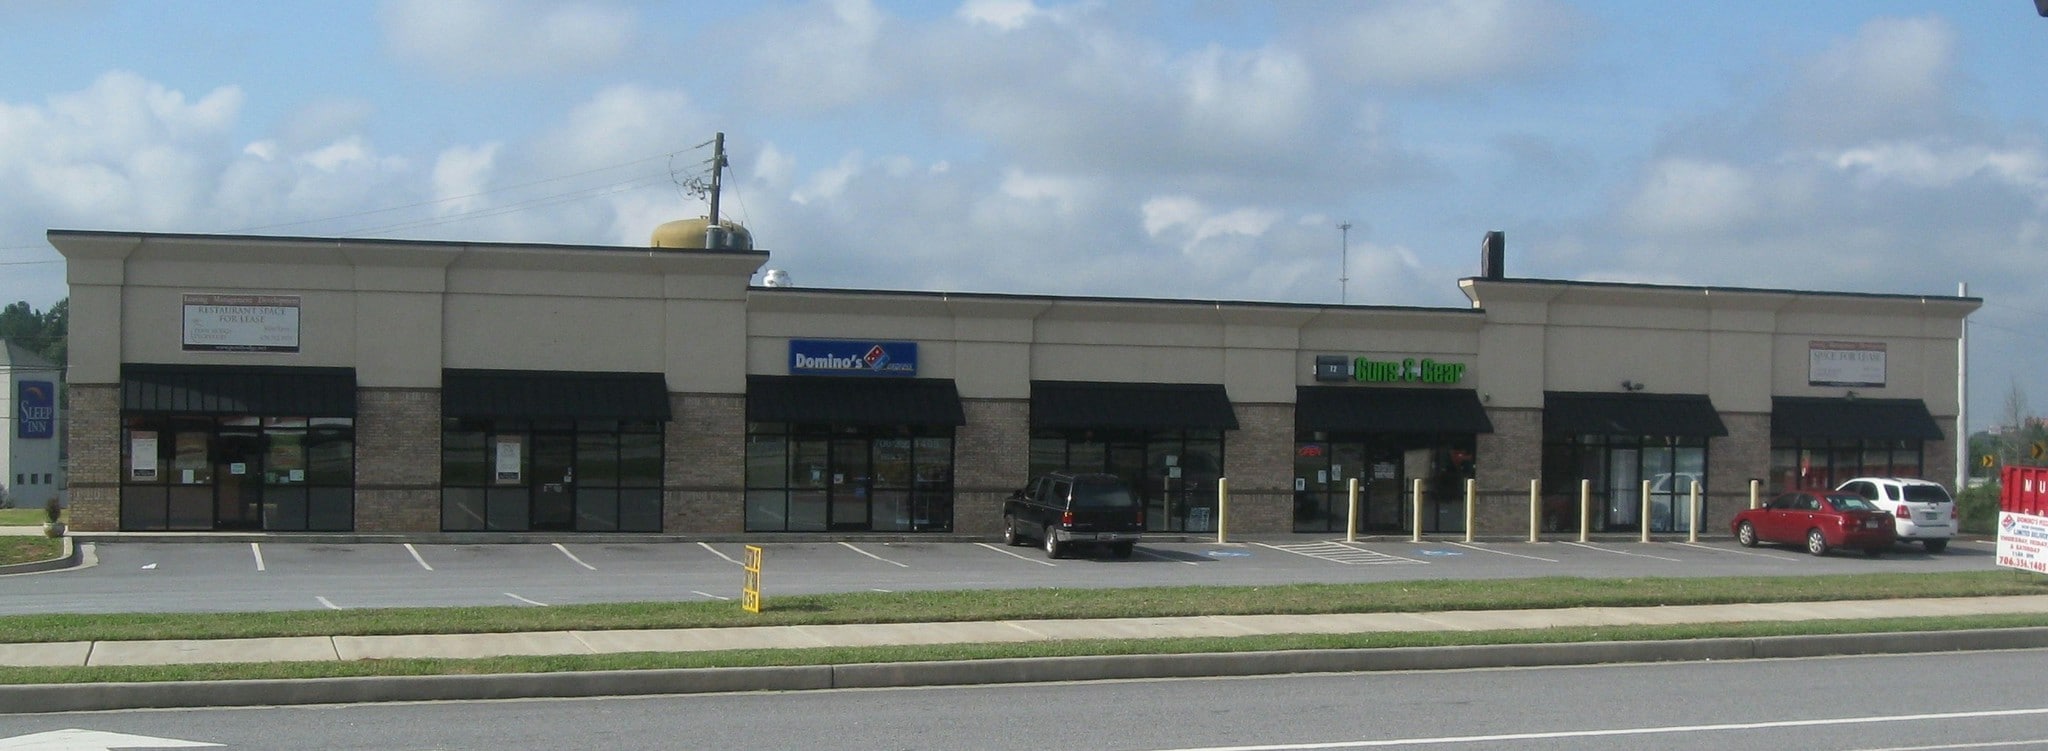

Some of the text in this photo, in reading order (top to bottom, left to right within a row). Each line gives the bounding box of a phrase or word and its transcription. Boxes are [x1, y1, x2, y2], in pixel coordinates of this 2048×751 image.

[198, 307, 286, 316] RESTAURANT SPACE
[240, 315, 265, 323] LEASE
[795, 353, 863, 369] Domino's
[1354, 356, 1465, 383] Guns & Gear
[21, 400, 53, 422] SLEEP
[28, 420, 47, 432] INN
